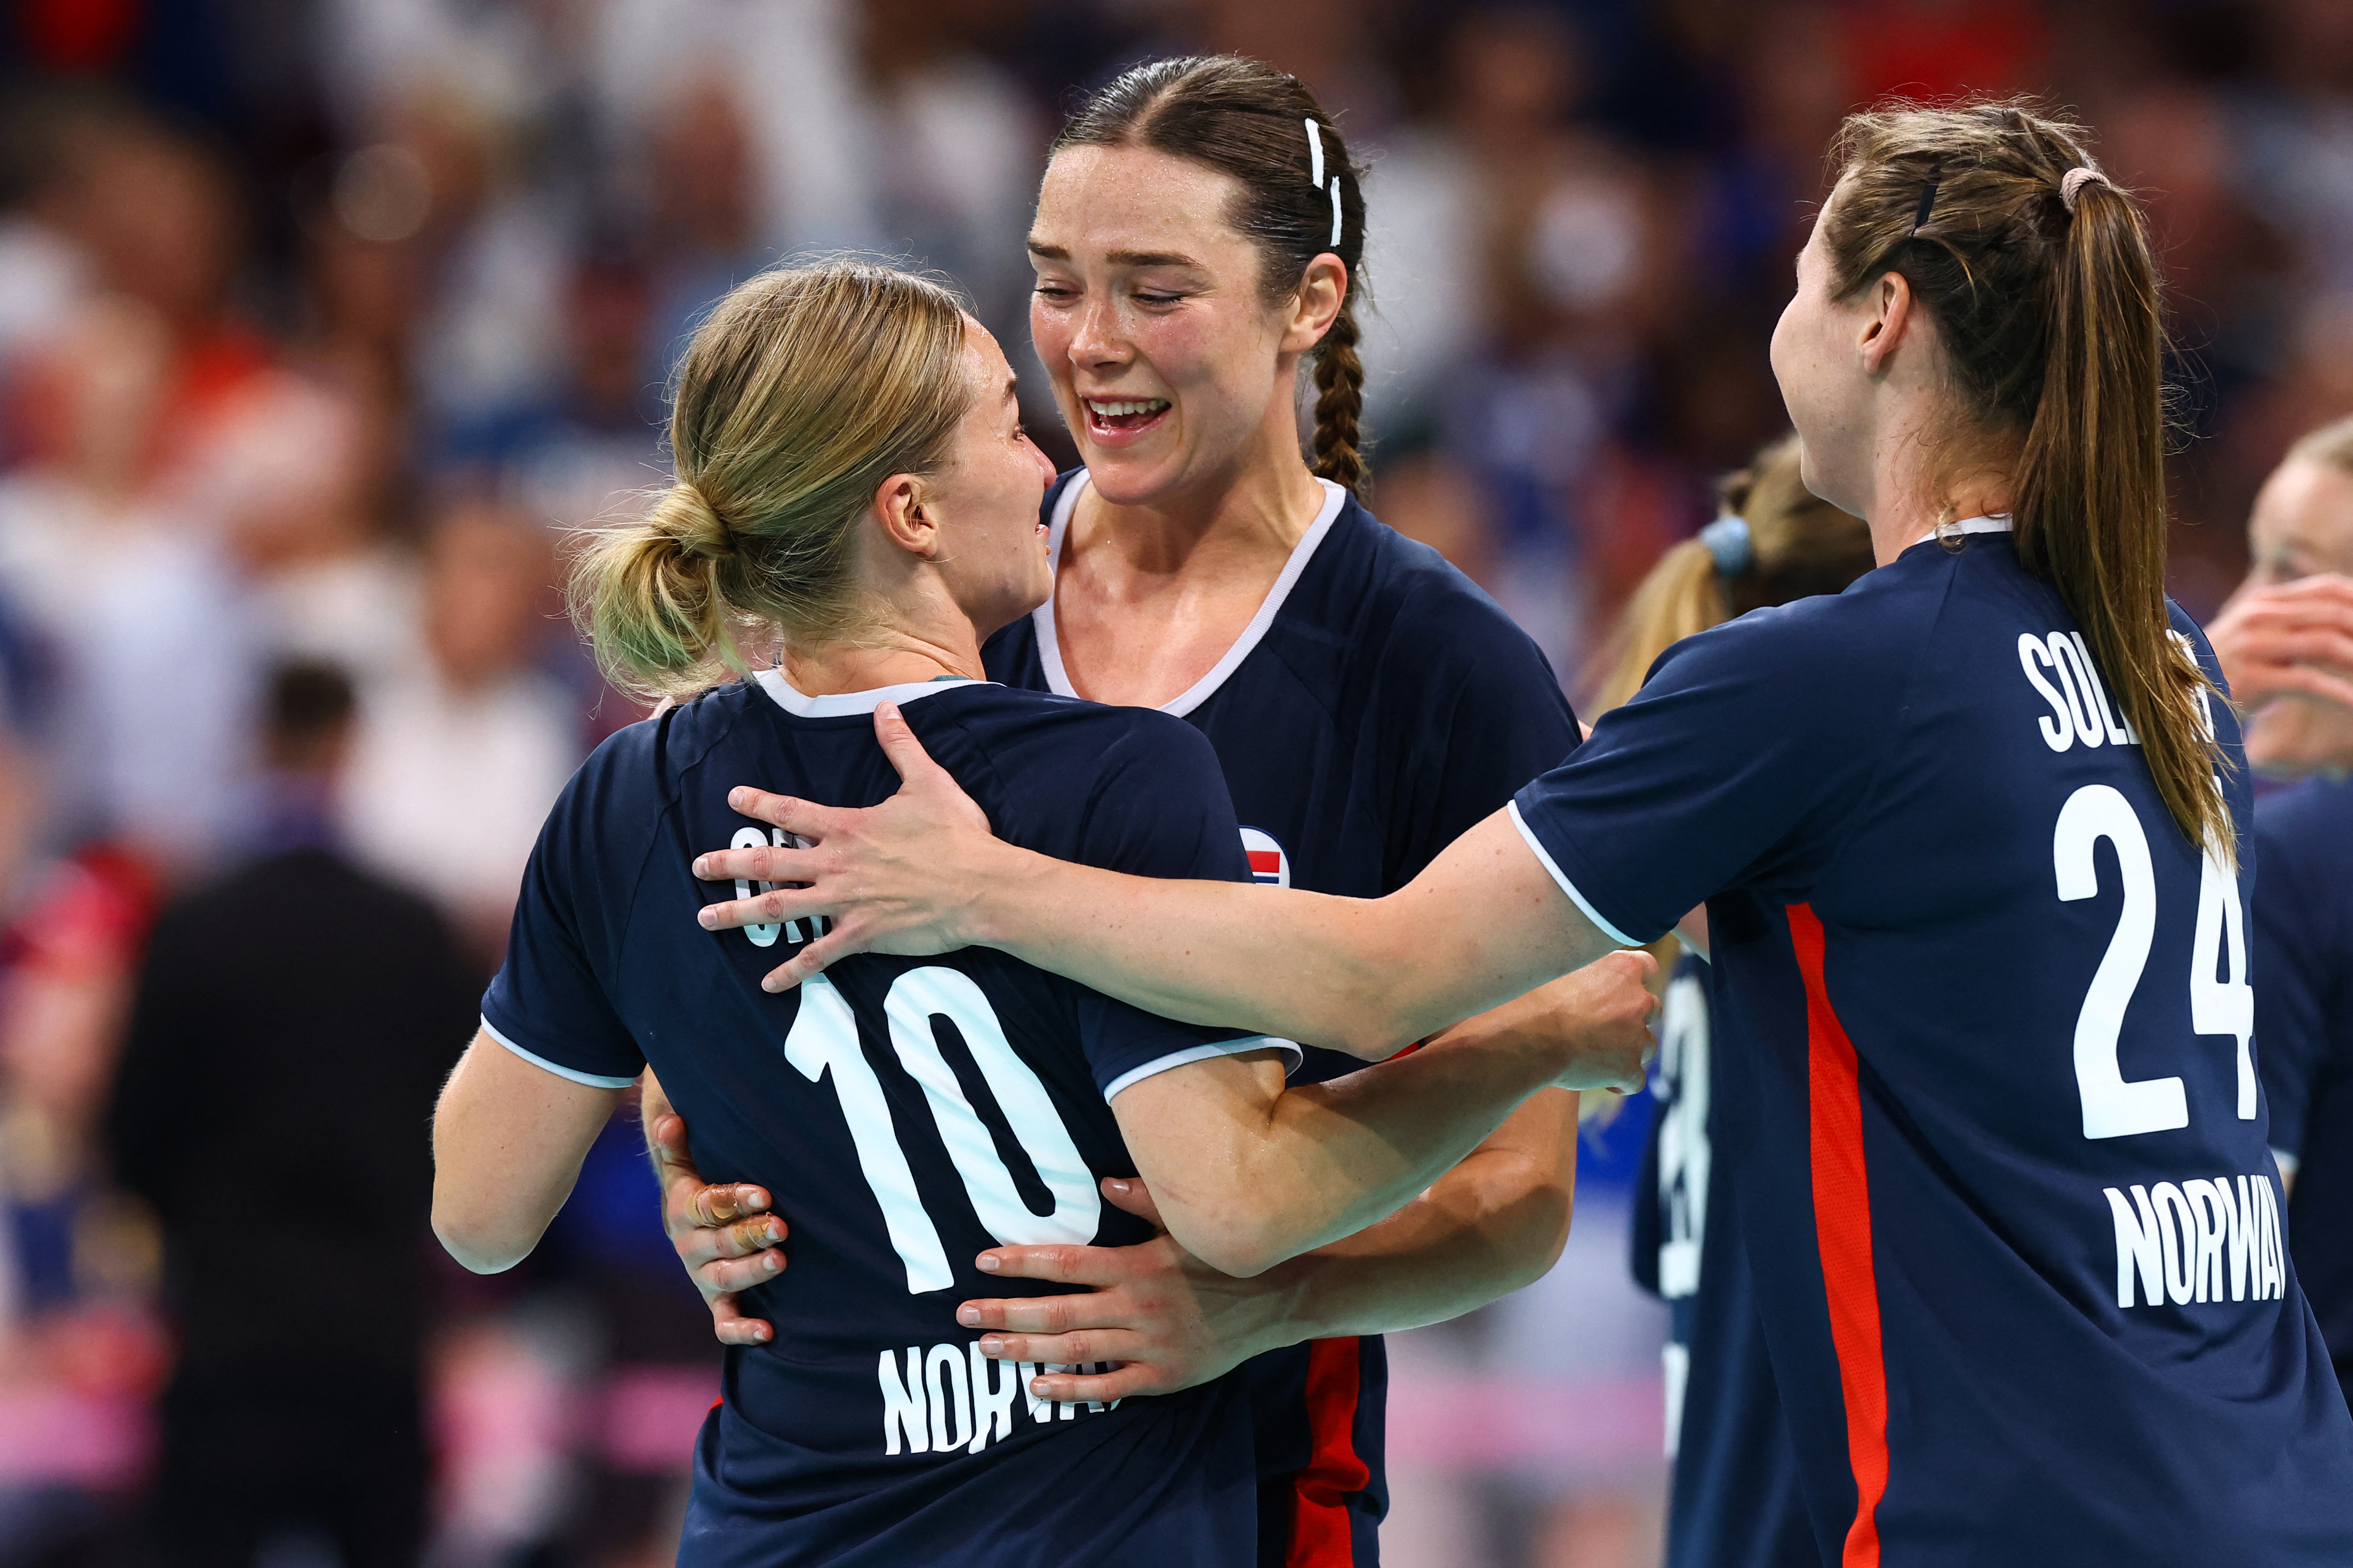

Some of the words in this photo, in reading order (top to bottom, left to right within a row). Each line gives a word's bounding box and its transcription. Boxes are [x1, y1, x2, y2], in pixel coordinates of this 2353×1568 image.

[2053, 776, 2257, 1140] 24
[784, 966, 1101, 1295] 10
[878, 1341, 1121, 1455] NOR
